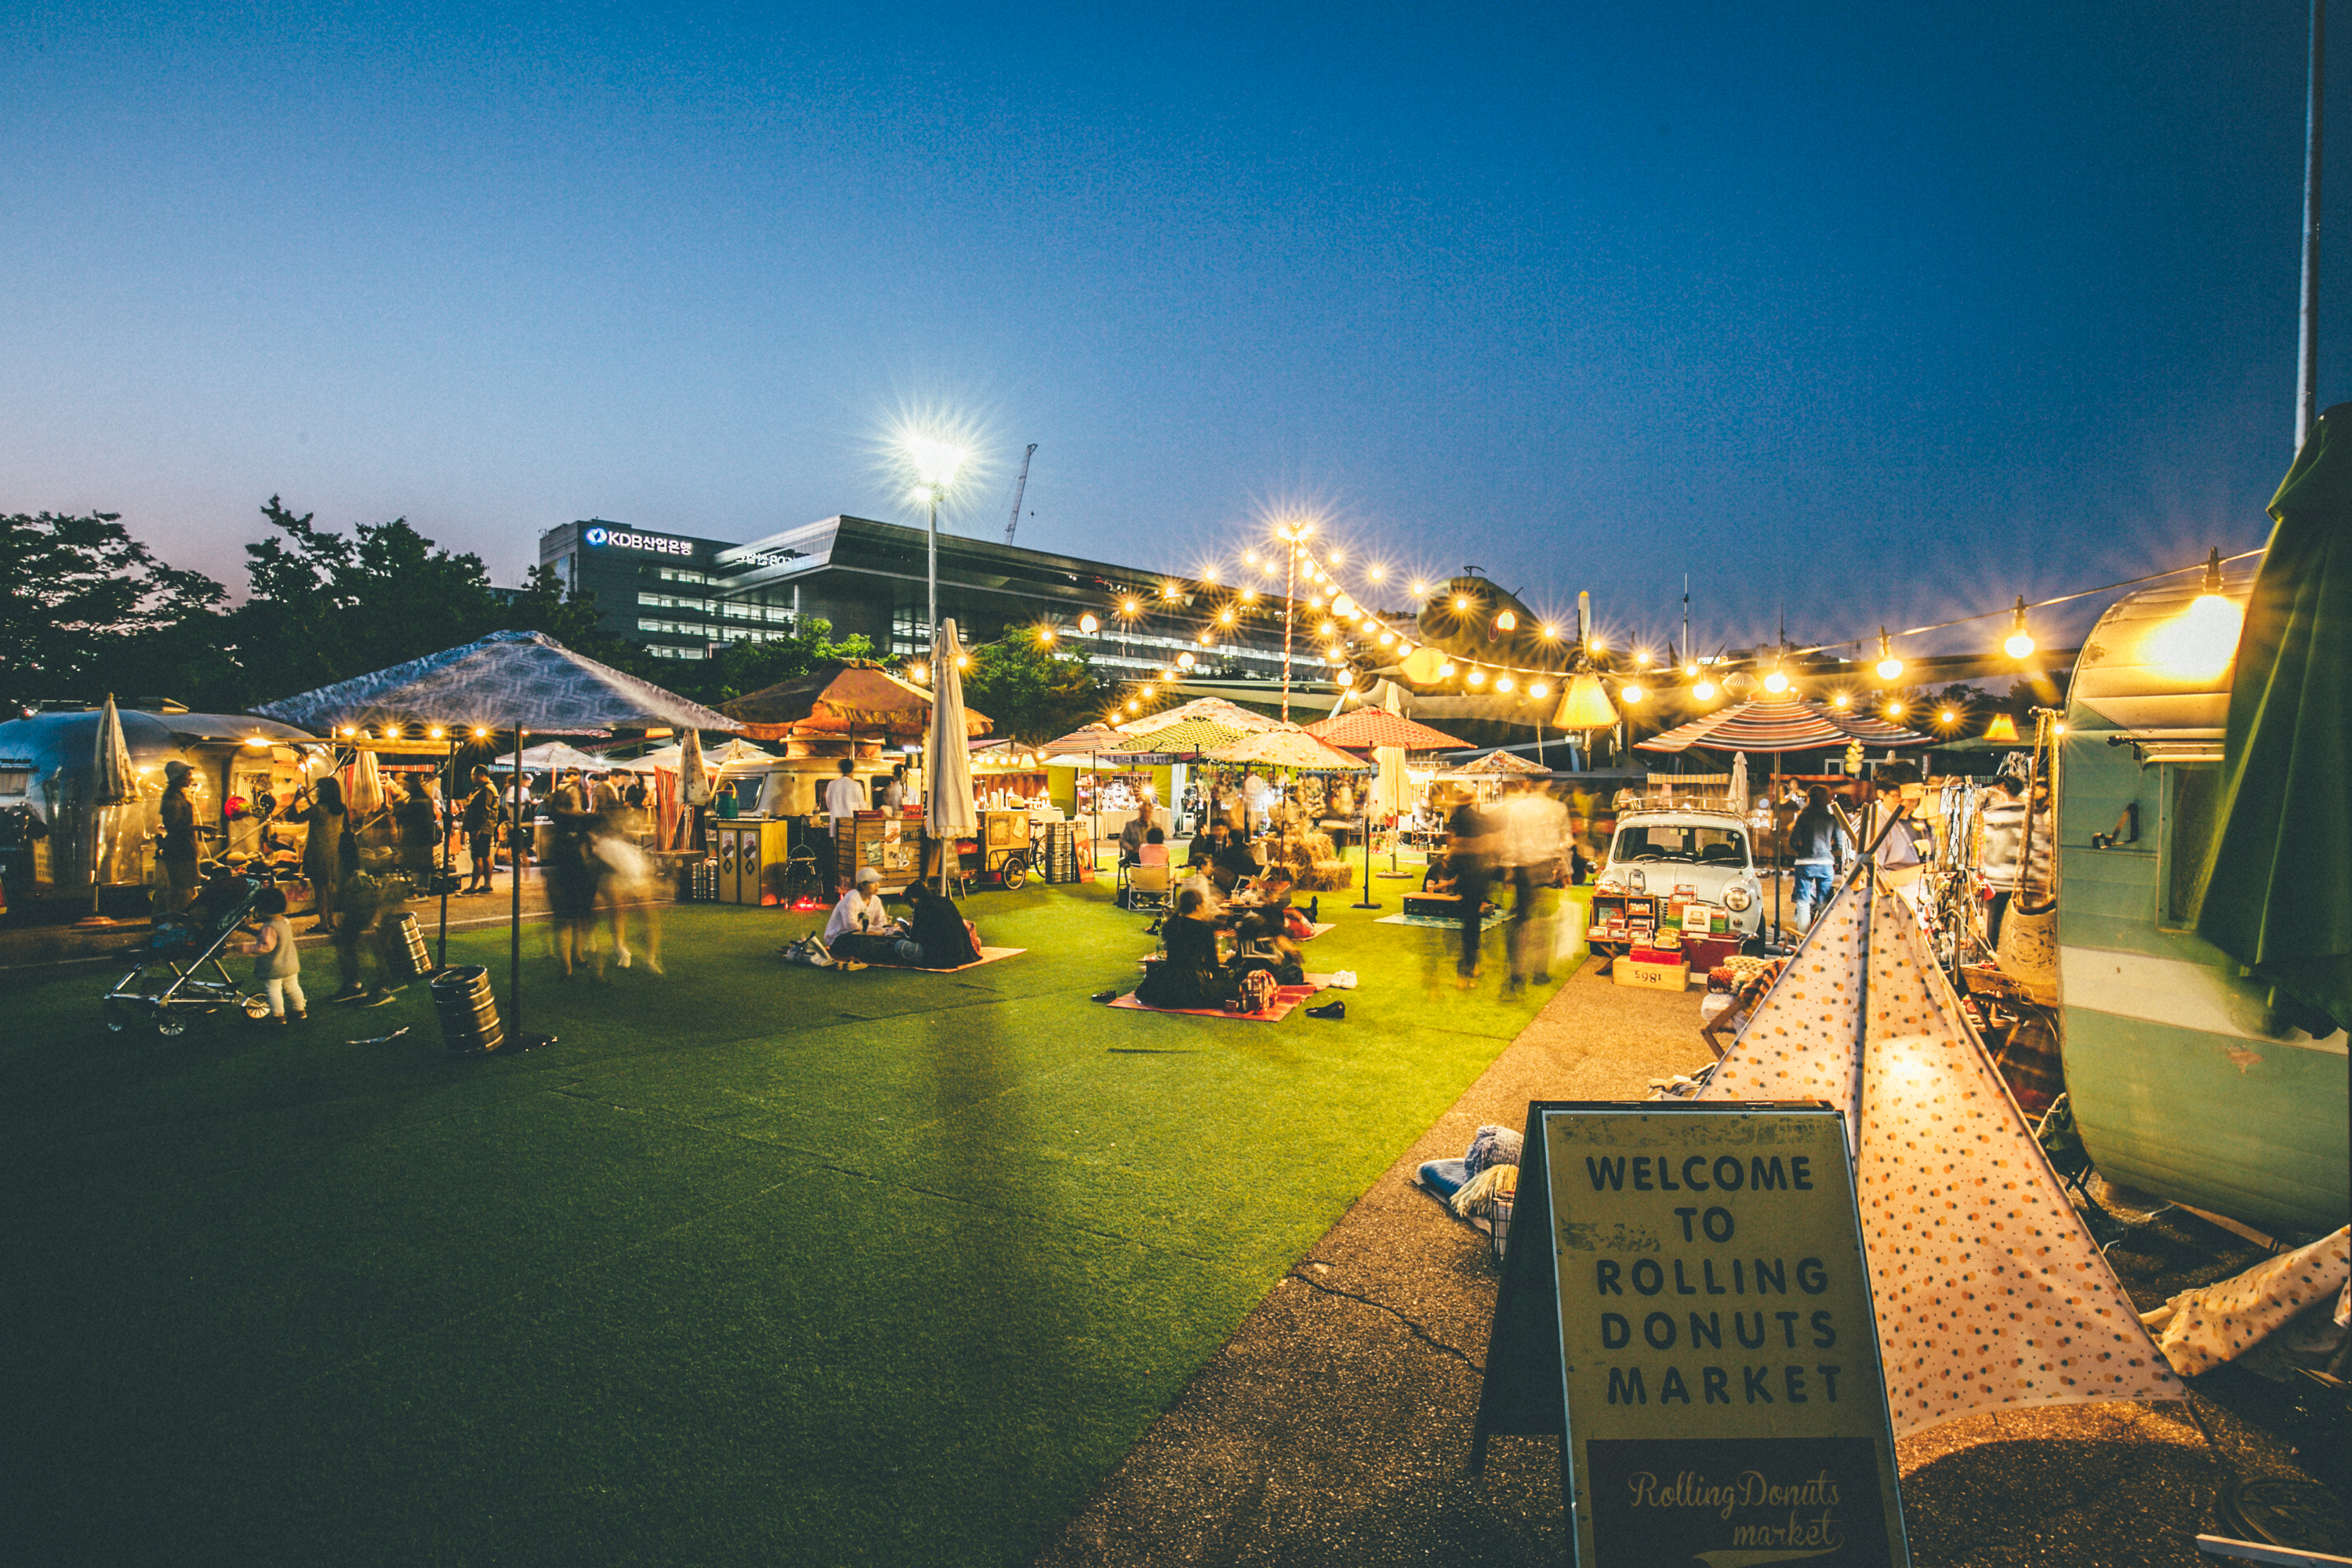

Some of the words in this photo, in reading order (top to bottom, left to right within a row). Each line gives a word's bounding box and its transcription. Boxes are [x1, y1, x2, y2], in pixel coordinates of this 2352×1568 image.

[608, 531, 692, 556] KDB산업은행
[1635, 970, 1661, 984] 1865
[1585, 1156, 1814, 1191] WELCOME
[1674, 1207, 1735, 1243] TO
[1596, 1258, 1828, 1296] ROLLING
[1601, 1311, 1838, 1350] DONUTS
[1607, 1365, 1842, 1405] MARKET
[1733, 1509, 1843, 1547] market
